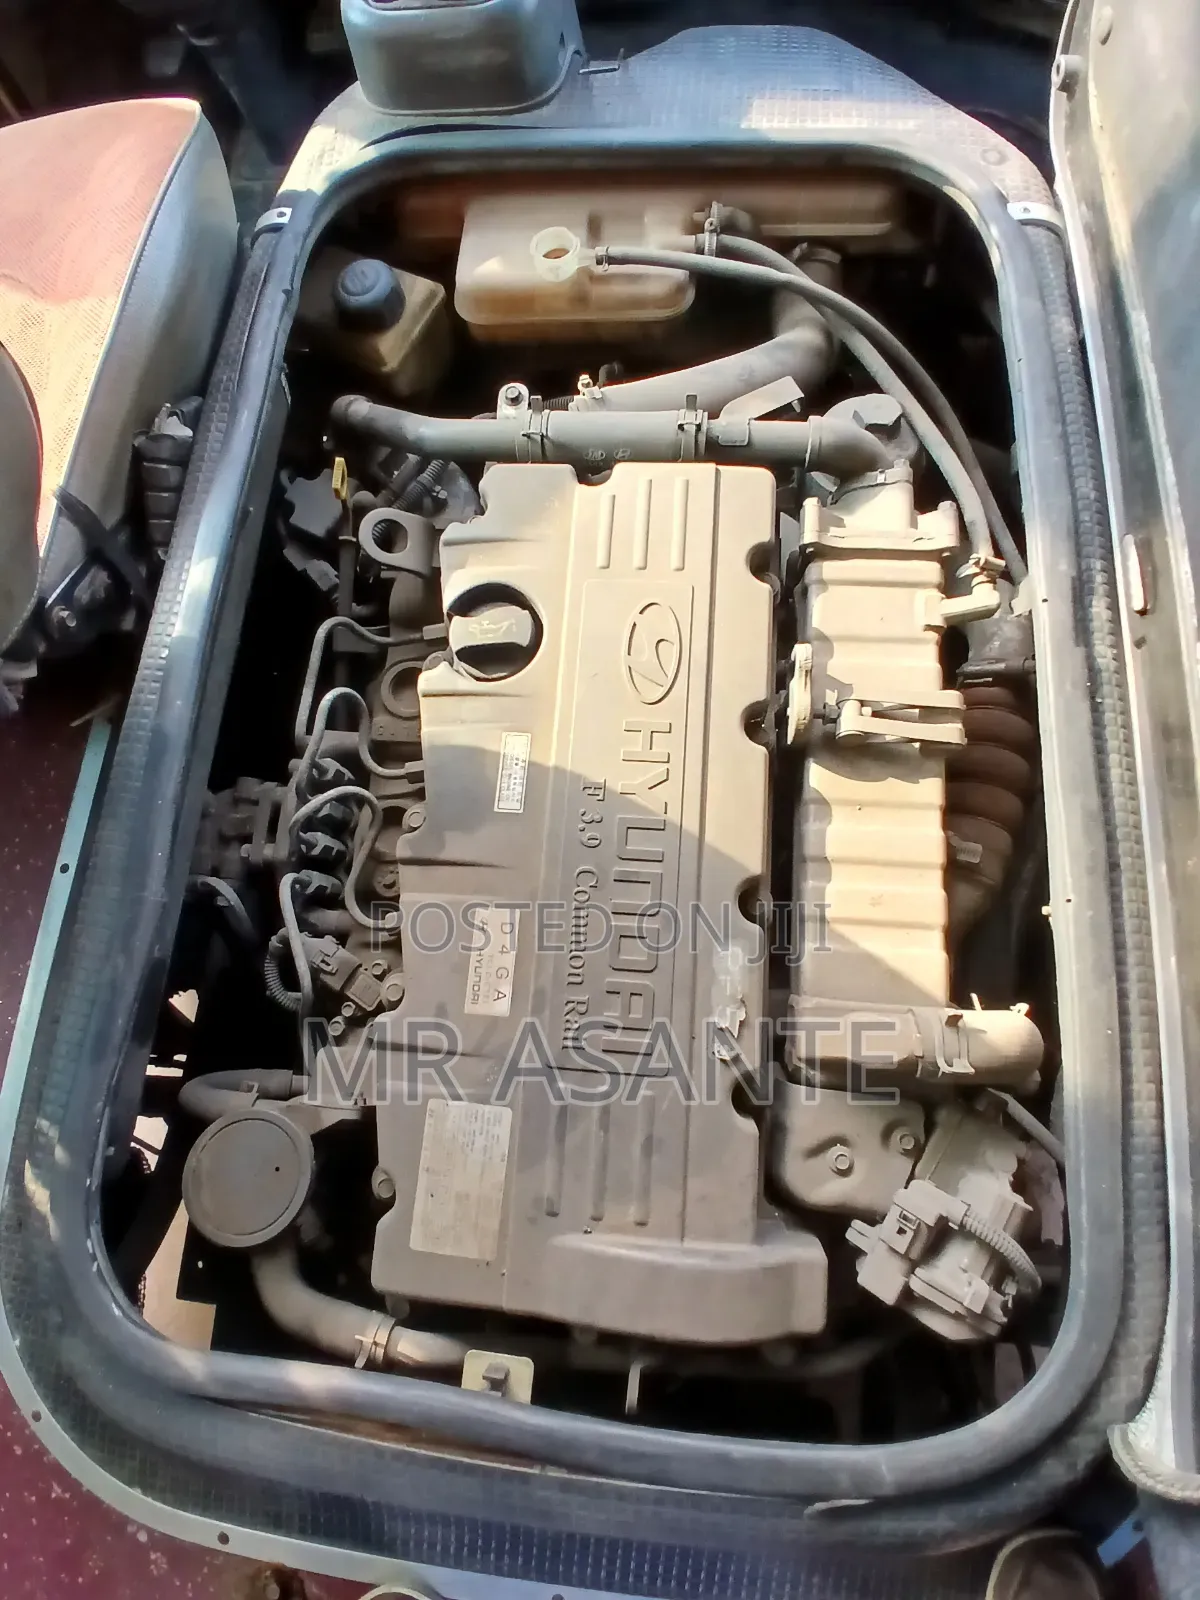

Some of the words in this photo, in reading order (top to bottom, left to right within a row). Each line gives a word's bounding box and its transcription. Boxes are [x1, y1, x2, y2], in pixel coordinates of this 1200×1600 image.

[581, 778, 606, 802] F
[578, 808, 604, 848] 3.9
[601, 719, 672, 1056] HYUNDAI
[567, 866, 599, 986] Common
[470, 948, 485, 1005] HYUNDAI
[561, 995, 590, 1050] Rail
